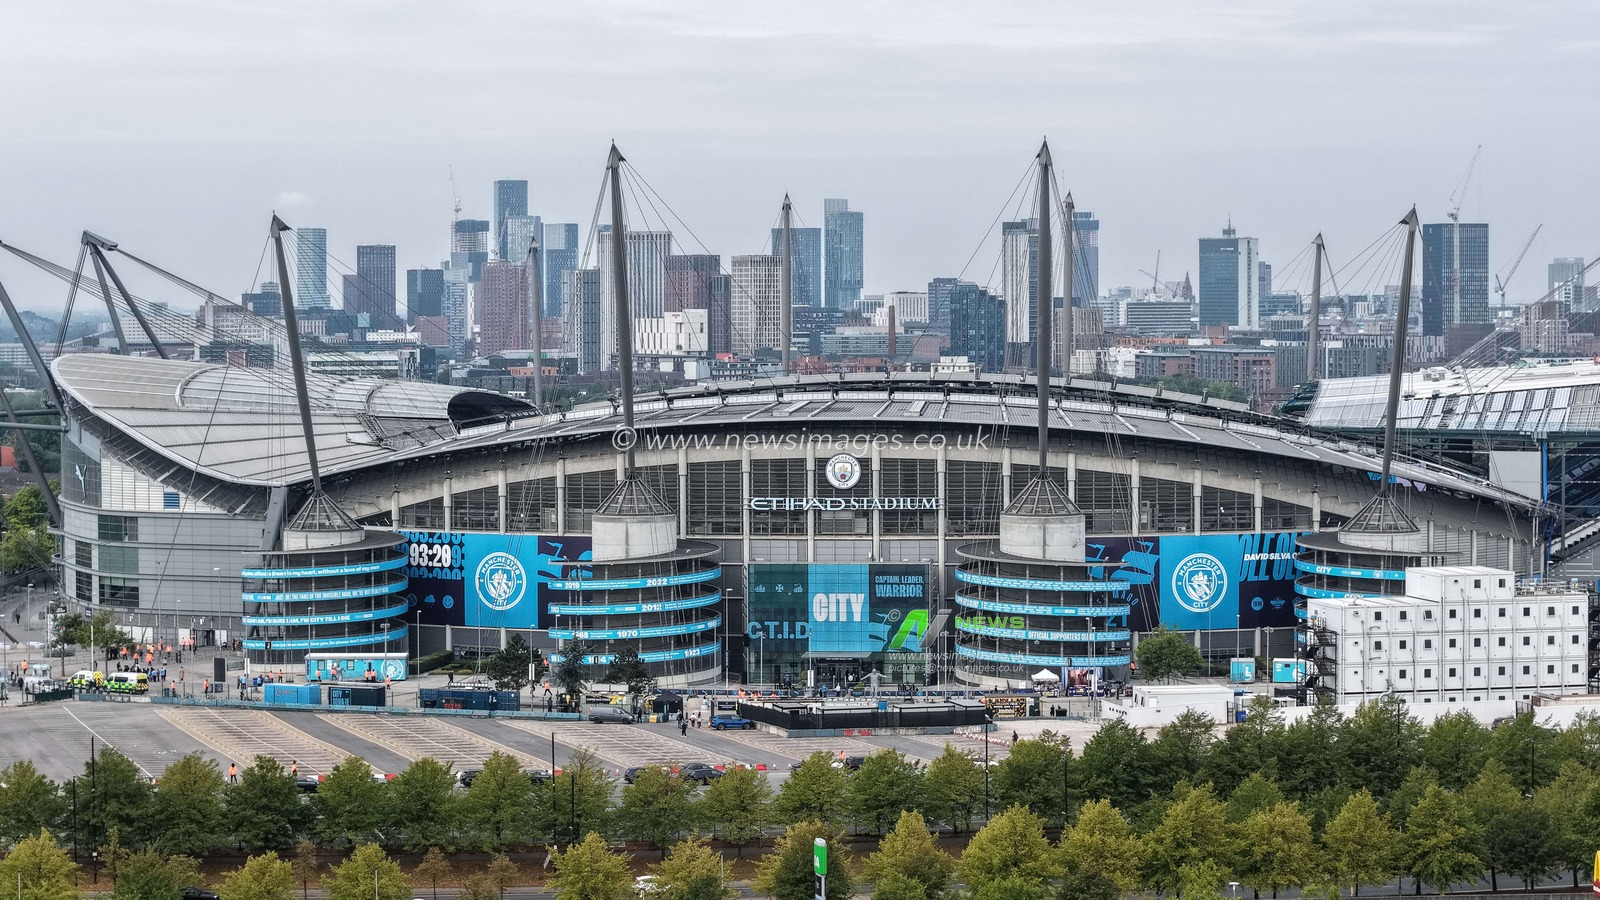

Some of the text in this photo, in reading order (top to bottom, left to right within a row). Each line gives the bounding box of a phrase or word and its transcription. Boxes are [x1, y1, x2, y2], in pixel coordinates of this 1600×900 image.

[750, 498, 937, 511] ETIHAD STADIUM
[410, 542, 452, 568] 93:20
[481, 556, 520, 575] MANCHESTER
[1178, 558, 1222, 576] MANCHESTER
[875, 584, 923, 598] WARRIOR
[812, 592, 865, 622] CITY
[748, 621, 810, 639] CT.I.D
[1050, 632, 1080, 640] SUPPORTERS
